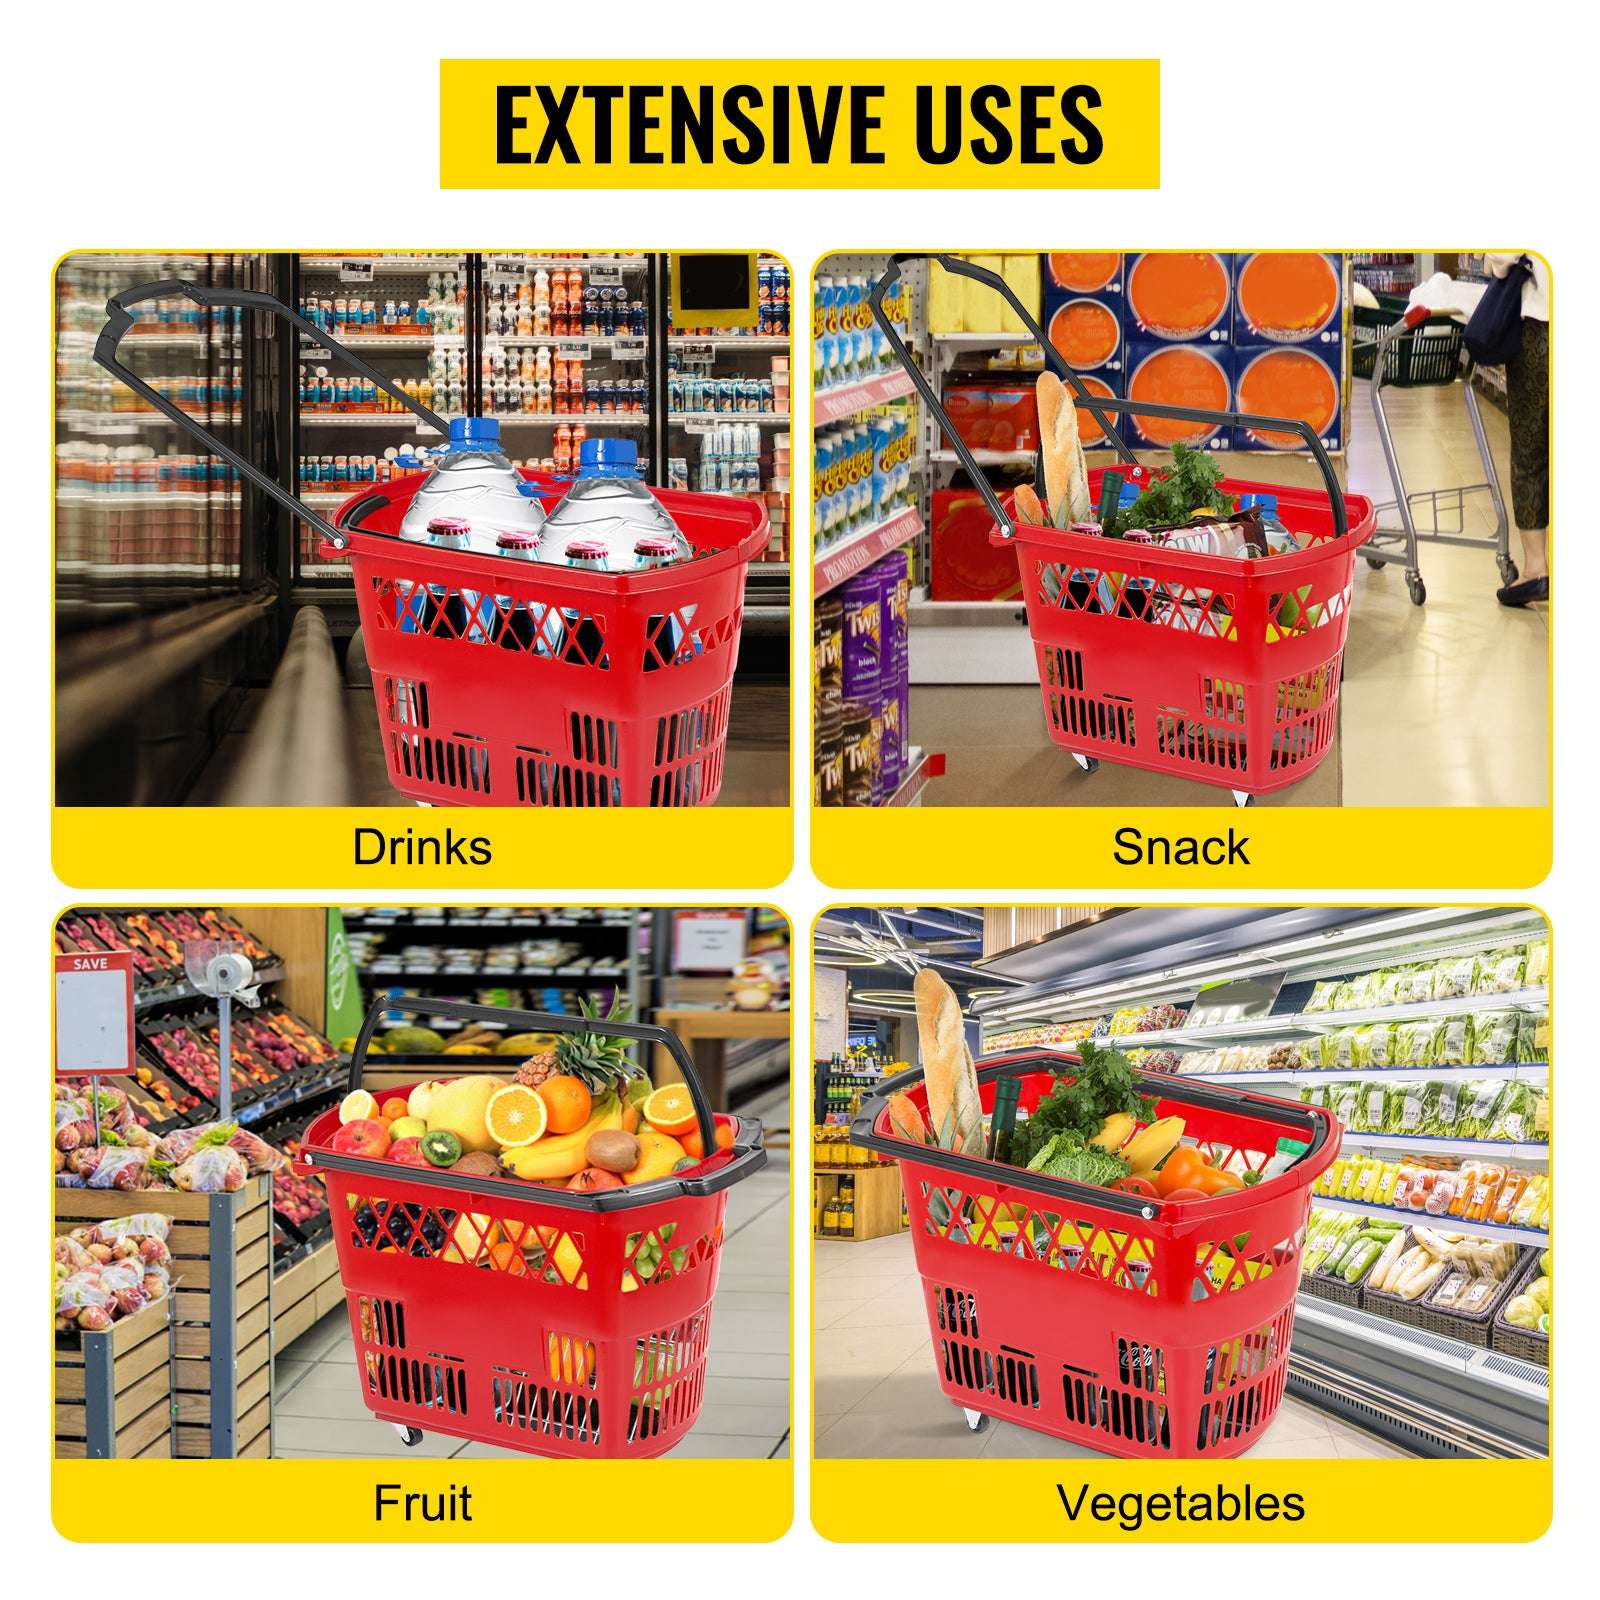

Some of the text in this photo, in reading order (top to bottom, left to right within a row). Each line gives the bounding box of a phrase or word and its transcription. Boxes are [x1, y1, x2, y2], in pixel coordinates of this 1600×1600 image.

[878, 516, 918, 549] PROMOTION
[822, 543, 872, 585] PROMOTION
[73, 957, 108, 970] SAVE
